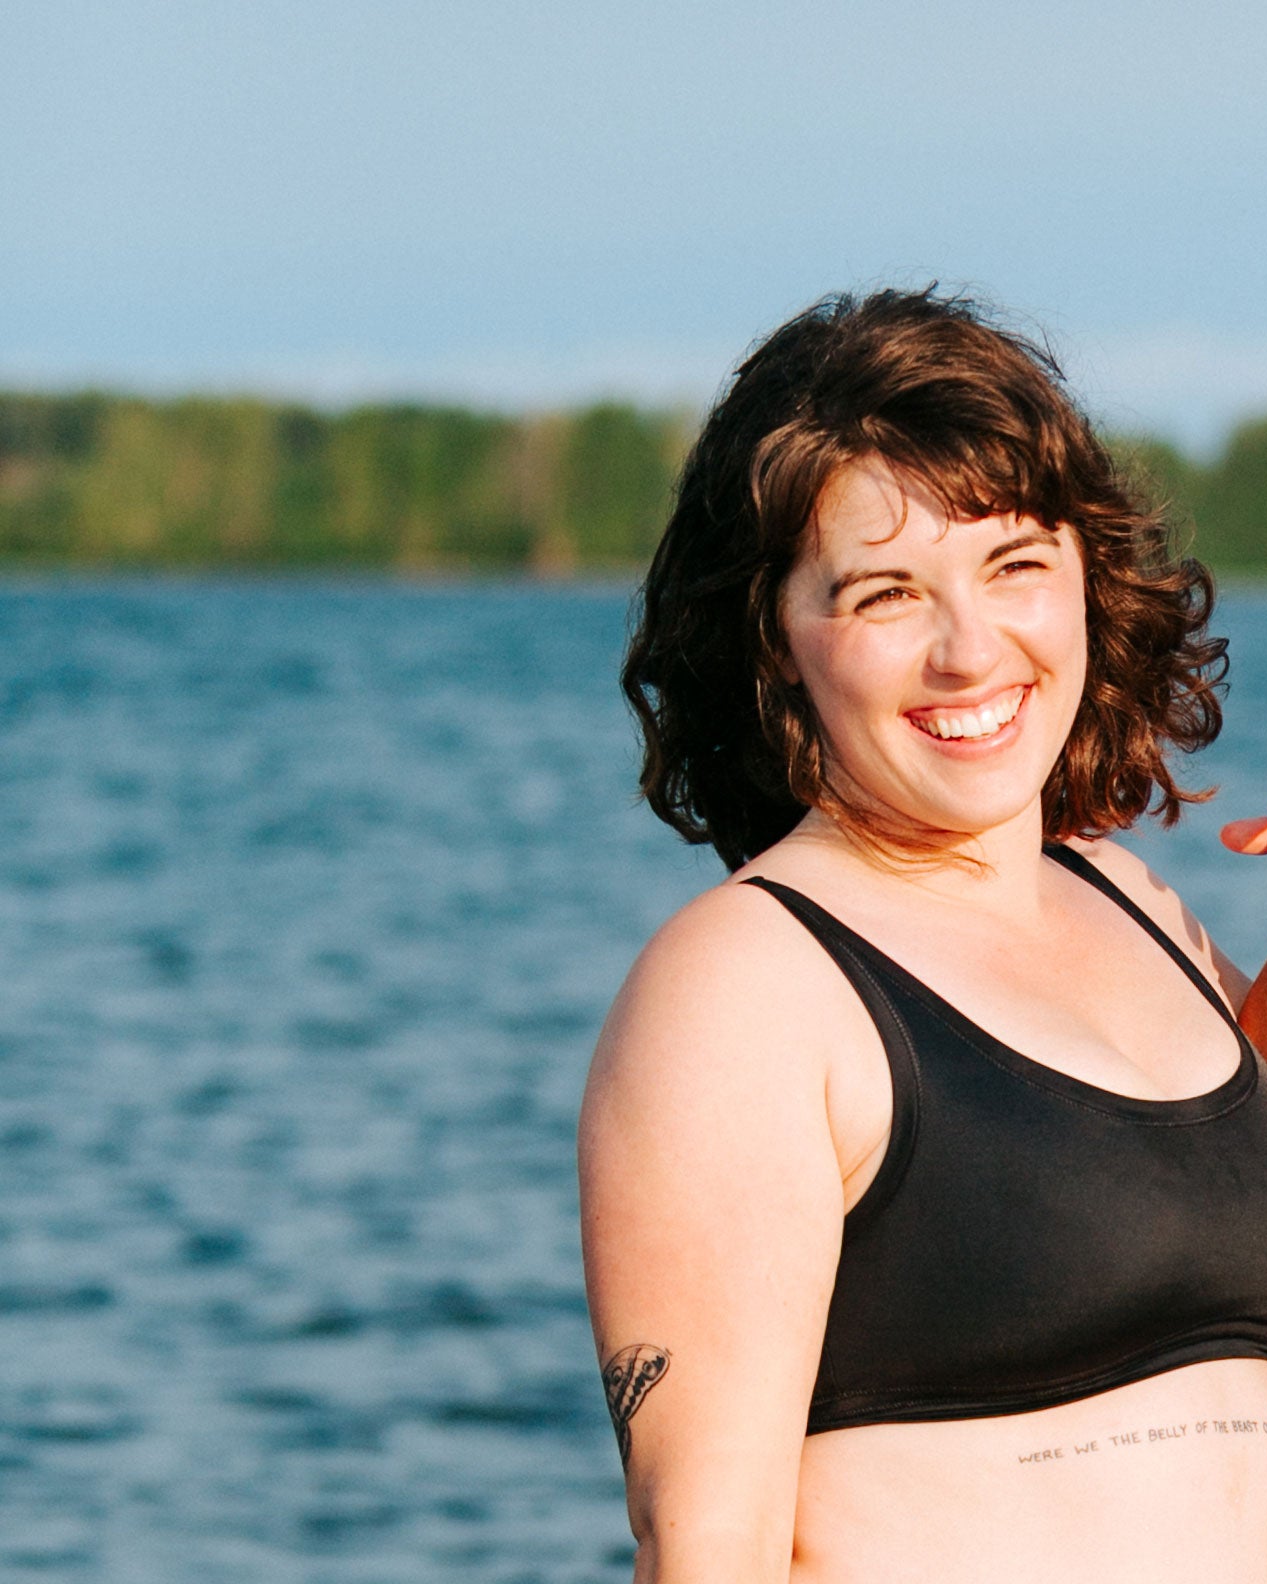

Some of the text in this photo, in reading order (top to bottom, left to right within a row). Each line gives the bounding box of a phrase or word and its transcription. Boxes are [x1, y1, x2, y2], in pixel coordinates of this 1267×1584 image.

[1018, 1448, 1063, 1464] WERE
[1075, 1440, 1100, 1455] WE
[1109, 1433, 1140, 1447] THE
[1148, 1424, 1187, 1442] BELLY
[1195, 1421, 1208, 1433] OF
[1212, 1420, 1228, 1434] THE
[1231, 1420, 1258, 1433] BEAST
